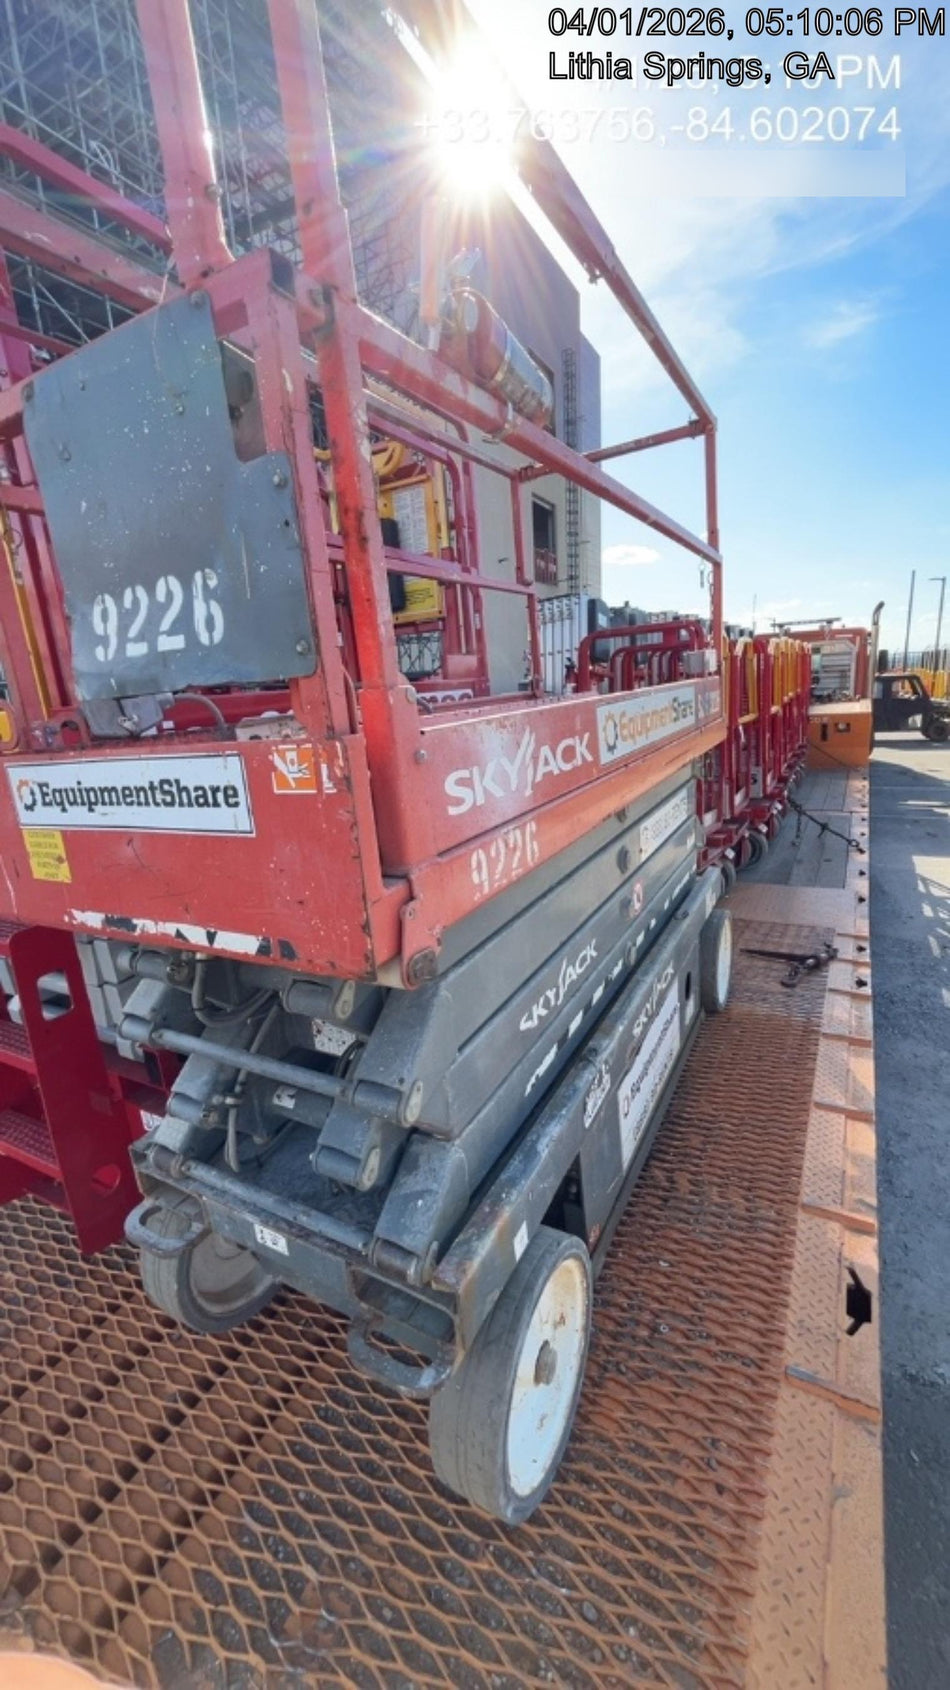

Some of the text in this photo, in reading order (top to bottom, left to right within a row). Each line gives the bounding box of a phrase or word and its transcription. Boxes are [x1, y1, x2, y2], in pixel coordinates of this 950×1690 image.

[92, 568, 225, 661] 9226
[38, 778, 240, 813] EquipmentShare
[444, 725, 593, 816] SKYJACK
[470, 820, 540, 901] 9226
[519, 939, 598, 1032] SKYJACK
